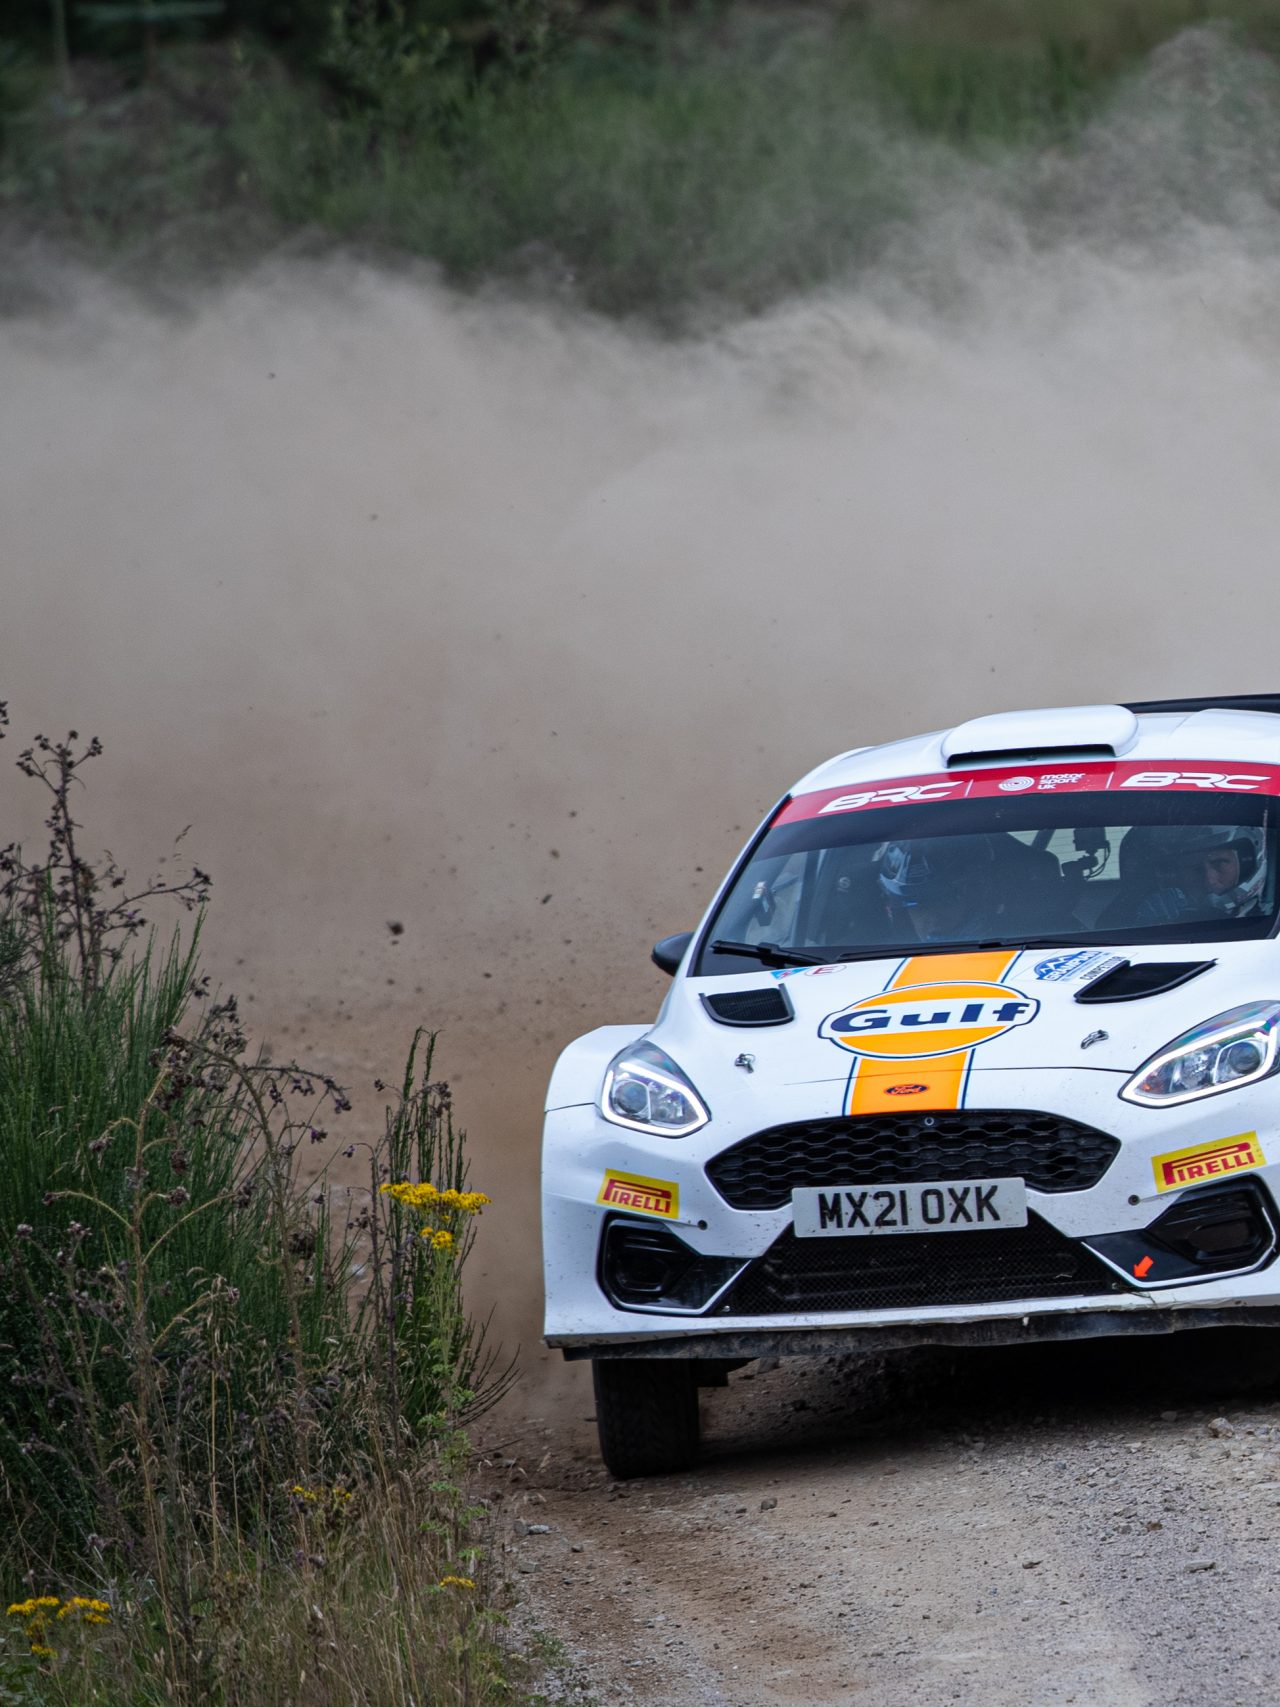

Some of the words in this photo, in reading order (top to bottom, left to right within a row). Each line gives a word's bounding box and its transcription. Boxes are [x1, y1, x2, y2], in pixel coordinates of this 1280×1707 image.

[1120, 772, 1272, 789] BRC
[818, 781, 964, 814] BRC
[812, 966, 838, 975] E
[830, 1002, 1030, 1032] Gulf
[1161, 1142, 1255, 1186] PIRELLI
[602, 1178, 672, 1213] PIRELLI
[818, 1189, 909, 1229] MX21
[921, 1185, 1001, 1225] OXK
